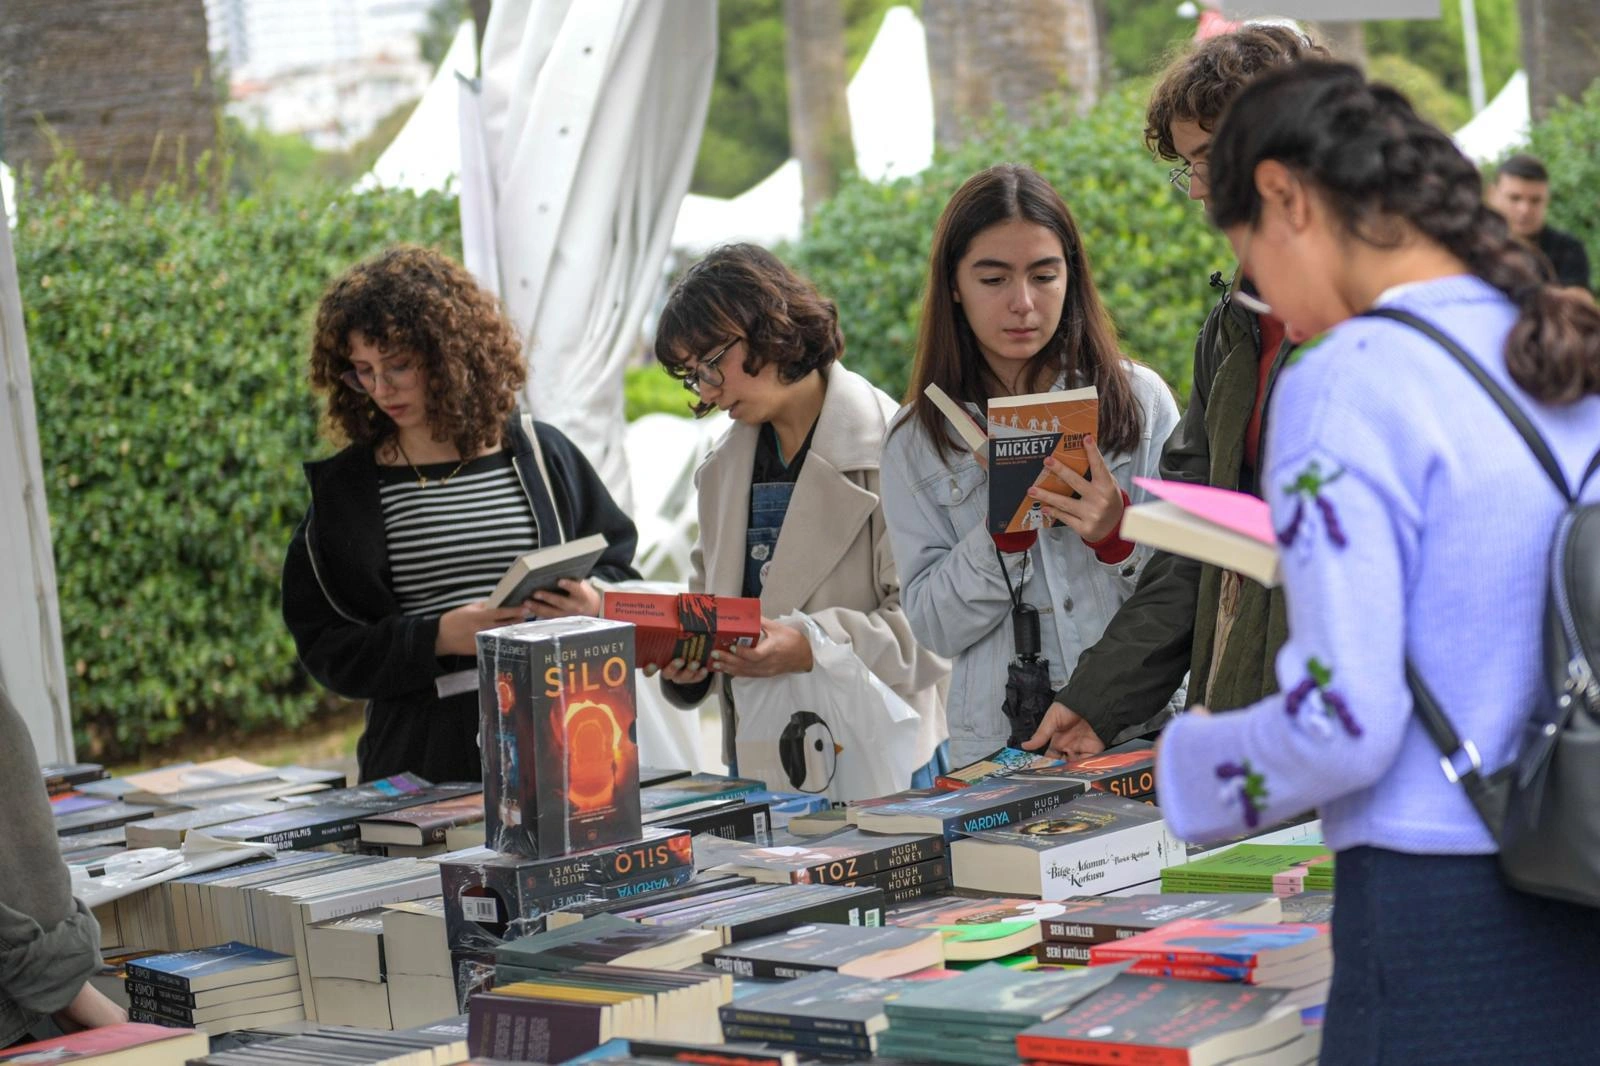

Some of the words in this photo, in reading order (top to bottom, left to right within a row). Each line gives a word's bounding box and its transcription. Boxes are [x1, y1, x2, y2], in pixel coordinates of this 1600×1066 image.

[544, 650, 578, 664] HUGH
[584, 643, 625, 657] HOWEY
[1034, 794, 1060, 809] HUGH
[891, 843, 918, 857] HUGH
[888, 851, 923, 867] HOWEY
[548, 861, 590, 879] HOWEY
[815, 857, 859, 884] TOZ
[891, 865, 919, 881] HUGH
[553, 872, 585, 888] HUGH
[888, 874, 923, 891] HOWEY
[1069, 871, 1105, 888] Korkusu
